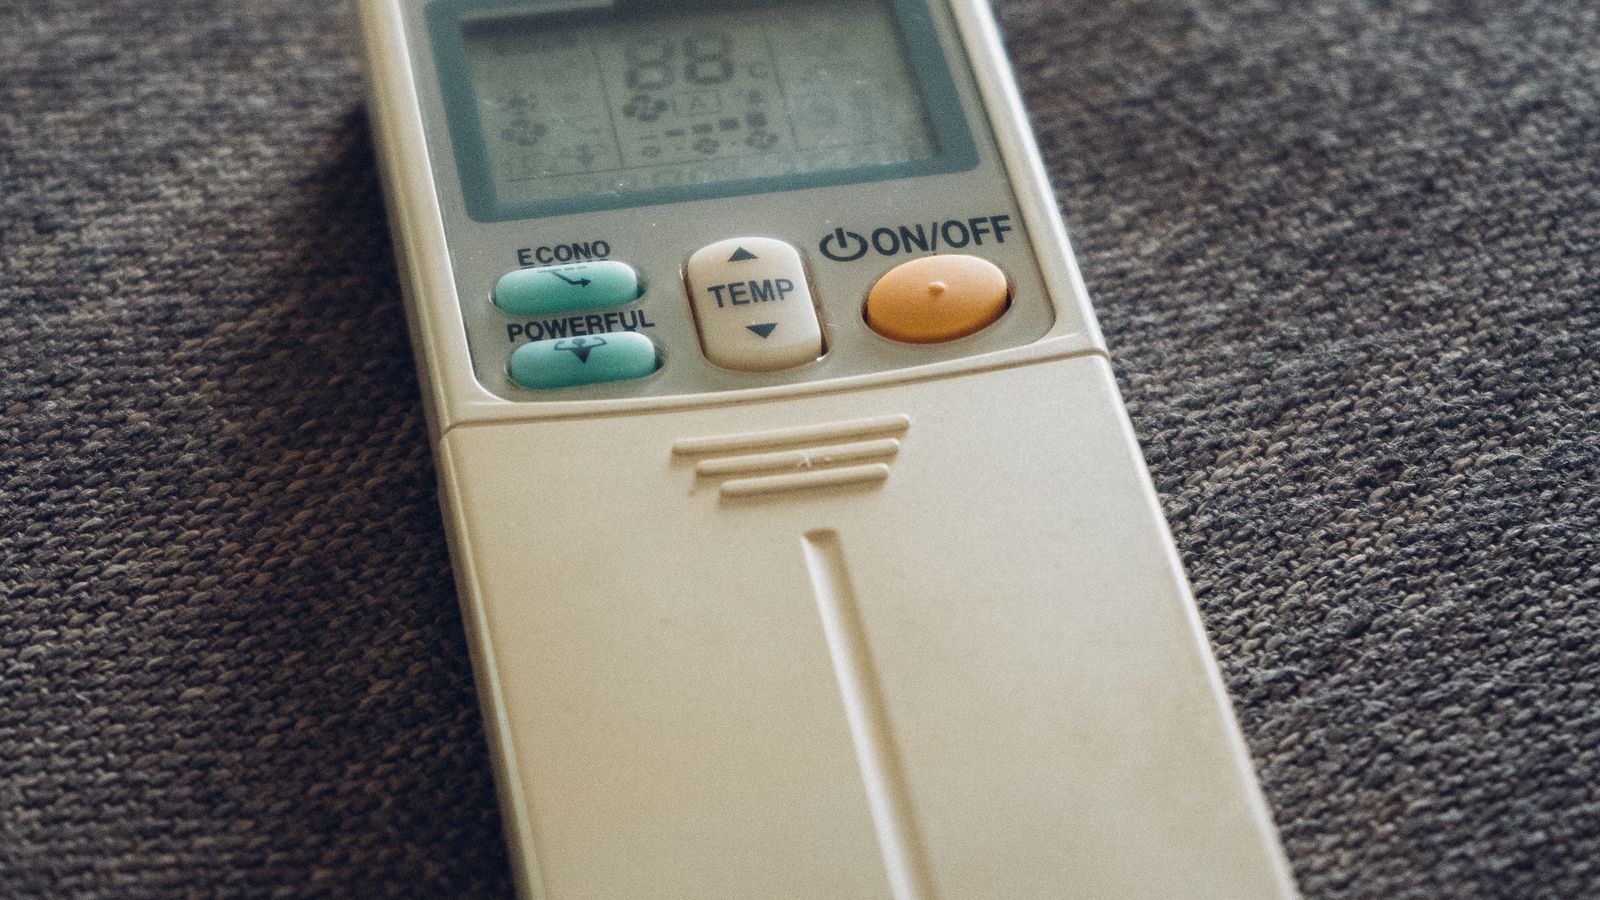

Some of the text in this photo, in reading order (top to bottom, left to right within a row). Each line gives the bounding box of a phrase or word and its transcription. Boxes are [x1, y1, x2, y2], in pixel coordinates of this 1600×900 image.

[871, 215, 1012, 256] ON/OFF
[517, 240, 611, 267] ECONO
[707, 278, 794, 308] TEMP
[507, 309, 656, 342] POWERFUL
